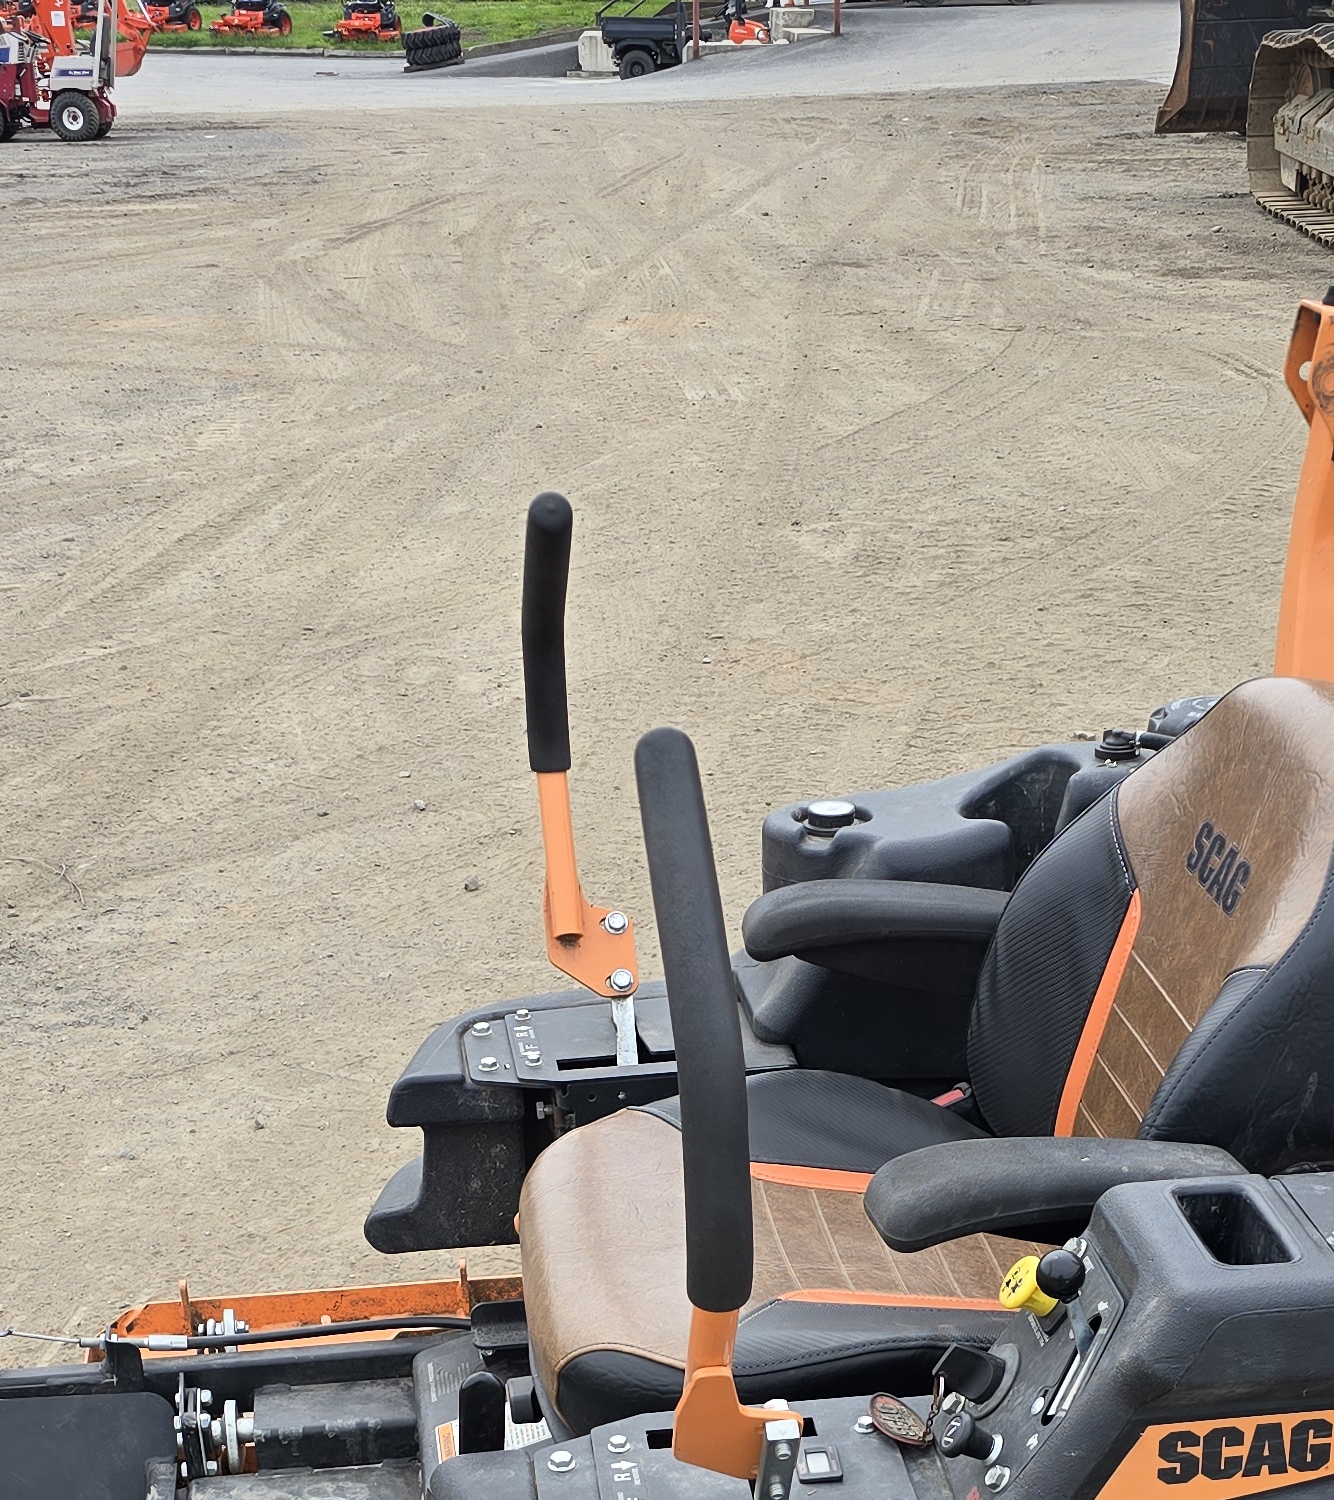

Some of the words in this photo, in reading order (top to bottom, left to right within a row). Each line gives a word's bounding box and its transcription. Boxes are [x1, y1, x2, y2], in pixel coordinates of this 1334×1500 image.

[1185, 818, 1253, 918] SCAG
[613, 1472, 632, 1482] R
[1156, 1417, 1334, 1486] SCAG
